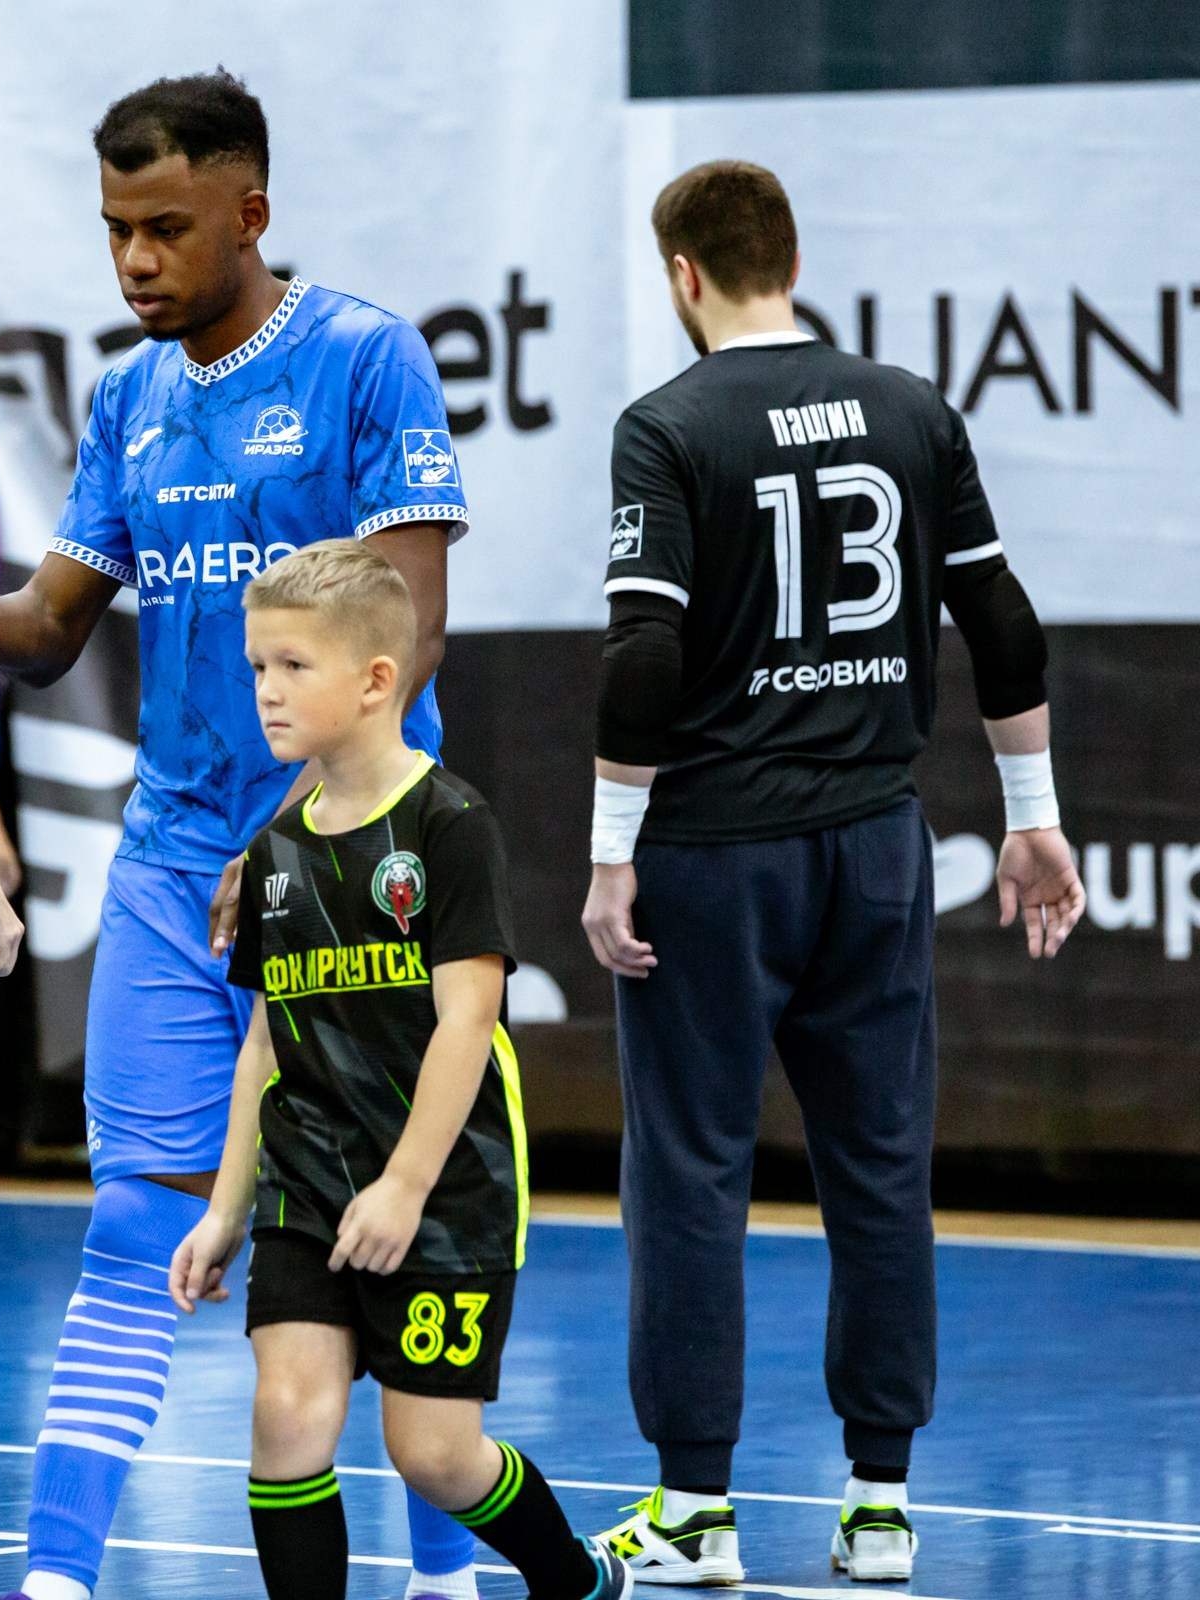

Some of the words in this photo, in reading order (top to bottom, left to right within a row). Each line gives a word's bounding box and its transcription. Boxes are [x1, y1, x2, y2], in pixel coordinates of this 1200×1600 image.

[793, 284, 1200, 415] UAN
[244, 444, 304, 456] ИРАЭРО
[407, 453, 454, 467] ПРОФИ
[156, 483, 237, 504] БЕТСИТИ
[754, 462, 903, 639] 13
[772, 656, 907, 693] сервико
[401, 1291, 490, 1367] 83
